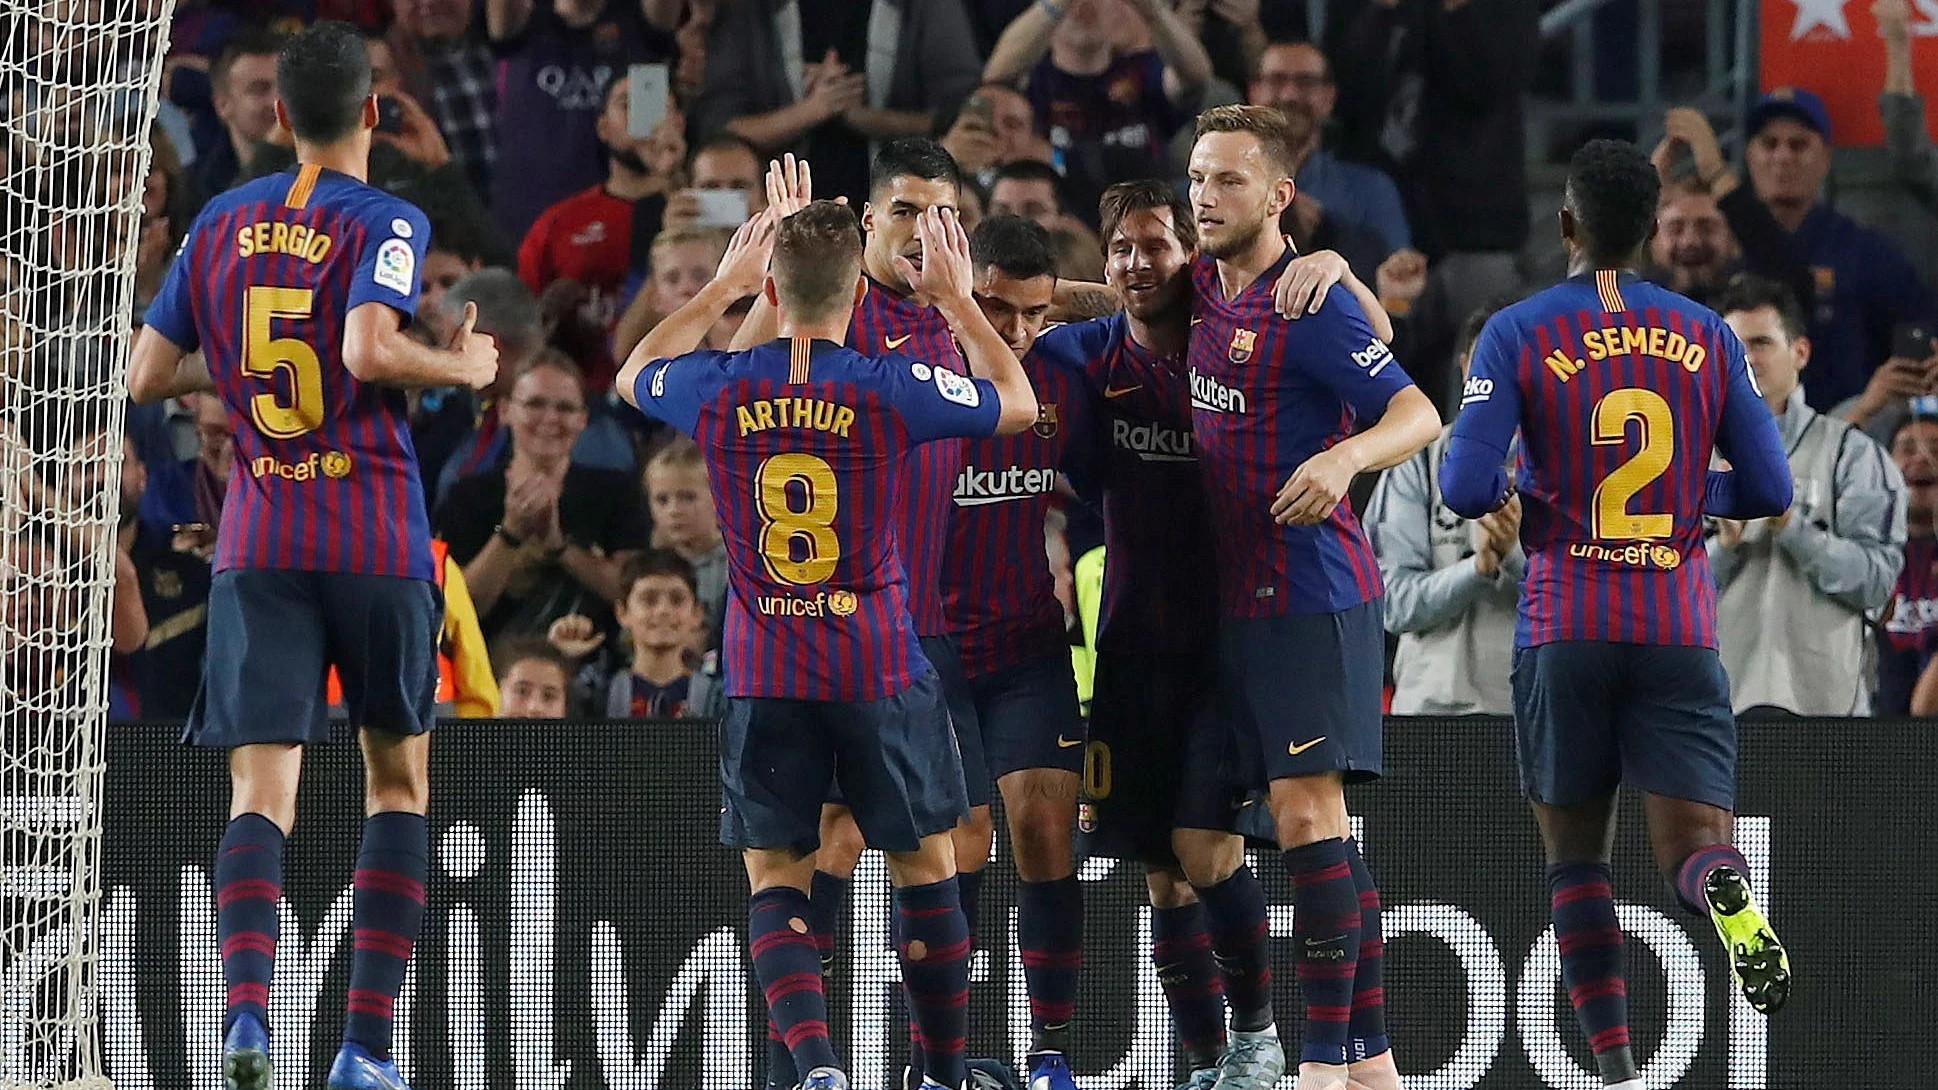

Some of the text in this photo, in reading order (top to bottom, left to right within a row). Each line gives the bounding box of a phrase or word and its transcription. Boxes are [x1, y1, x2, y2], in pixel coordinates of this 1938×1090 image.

[237, 220, 331, 264] SERGIO
[241, 286, 325, 440] 5
[1350, 337, 1389, 368] bek
[1544, 327, 1706, 383] N. SEMEDO
[1188, 366, 1246, 414] kuten
[735, 397, 856, 437] ARTHUR
[1113, 418, 1192, 455] Raku
[252, 452, 319, 481] unicef
[1590, 387, 1675, 541] 2
[754, 452, 841, 587] 8
[1570, 543, 1651, 565] unicef
[757, 592, 826, 617] unicef
